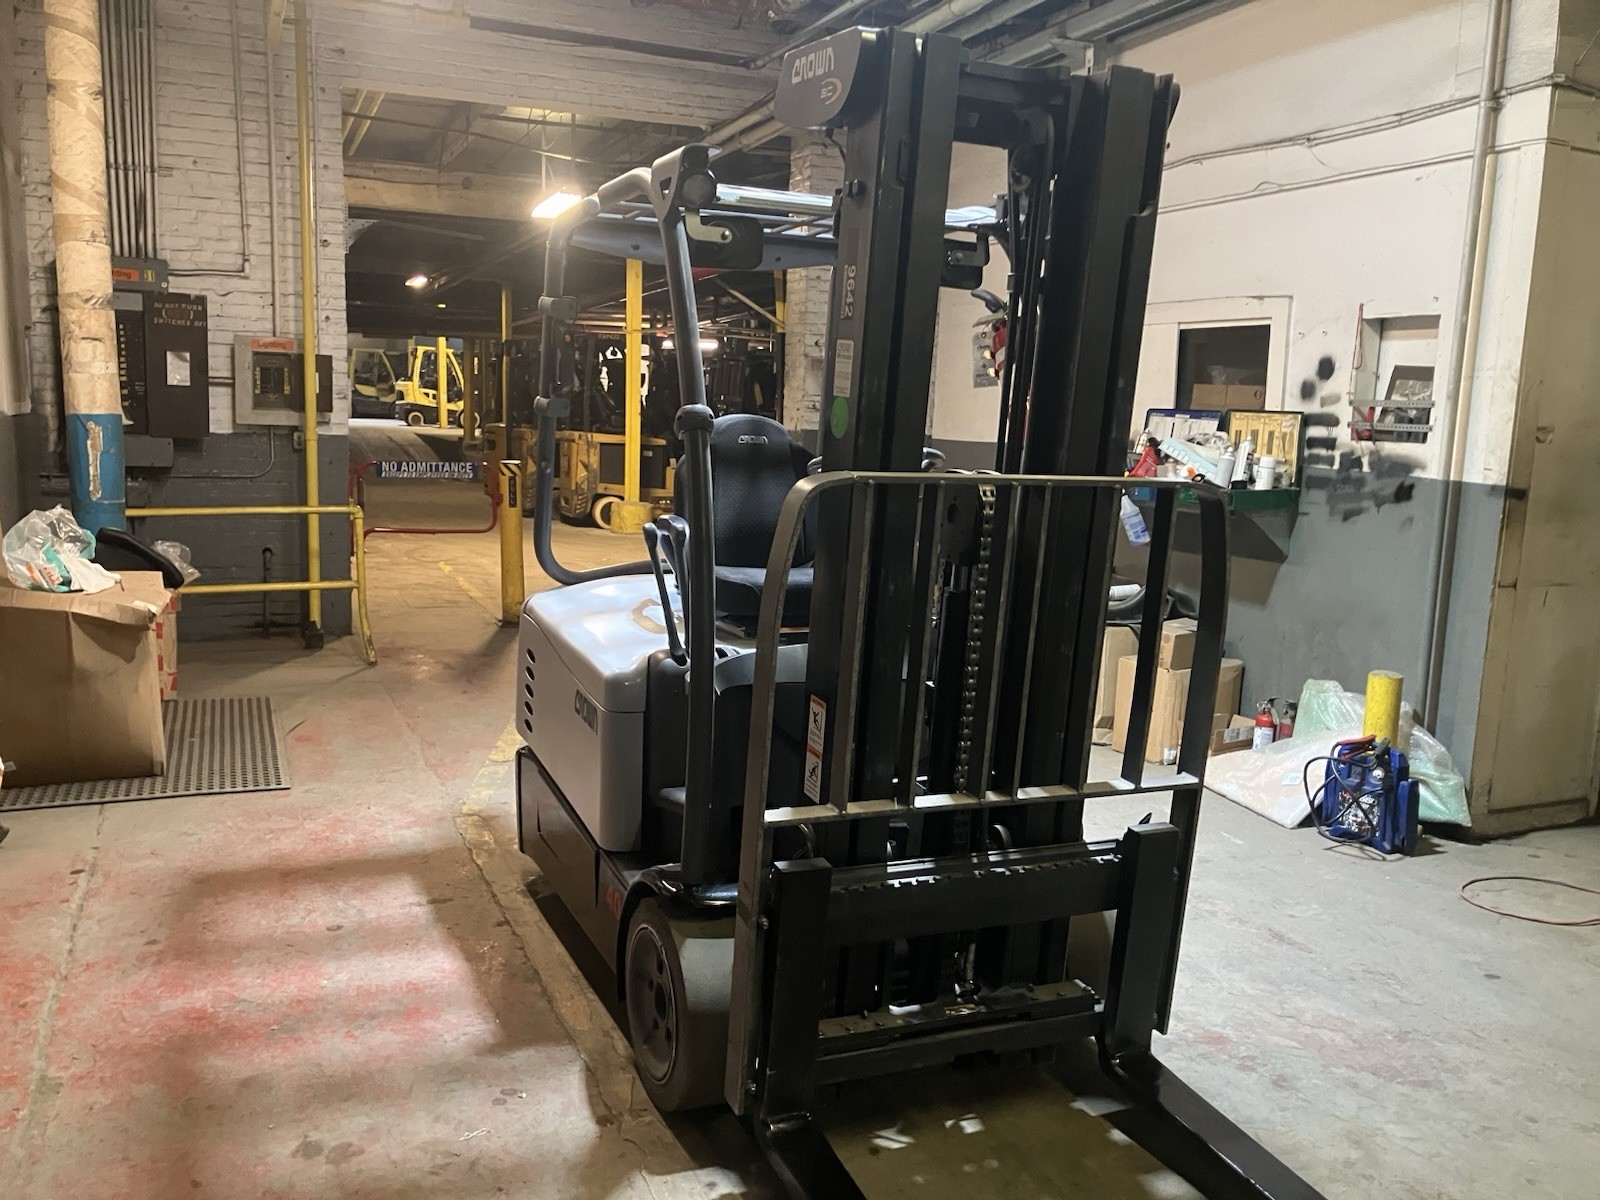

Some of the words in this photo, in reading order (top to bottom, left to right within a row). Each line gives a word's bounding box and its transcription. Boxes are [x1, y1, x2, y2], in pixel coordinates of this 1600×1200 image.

[845, 265, 857, 317] 9642
[153, 317, 191, 327] SWITCHES
[257, 338, 288, 351] Lighting
[381, 461, 398, 472] NO
[401, 461, 474, 473] ADMITTANCE
